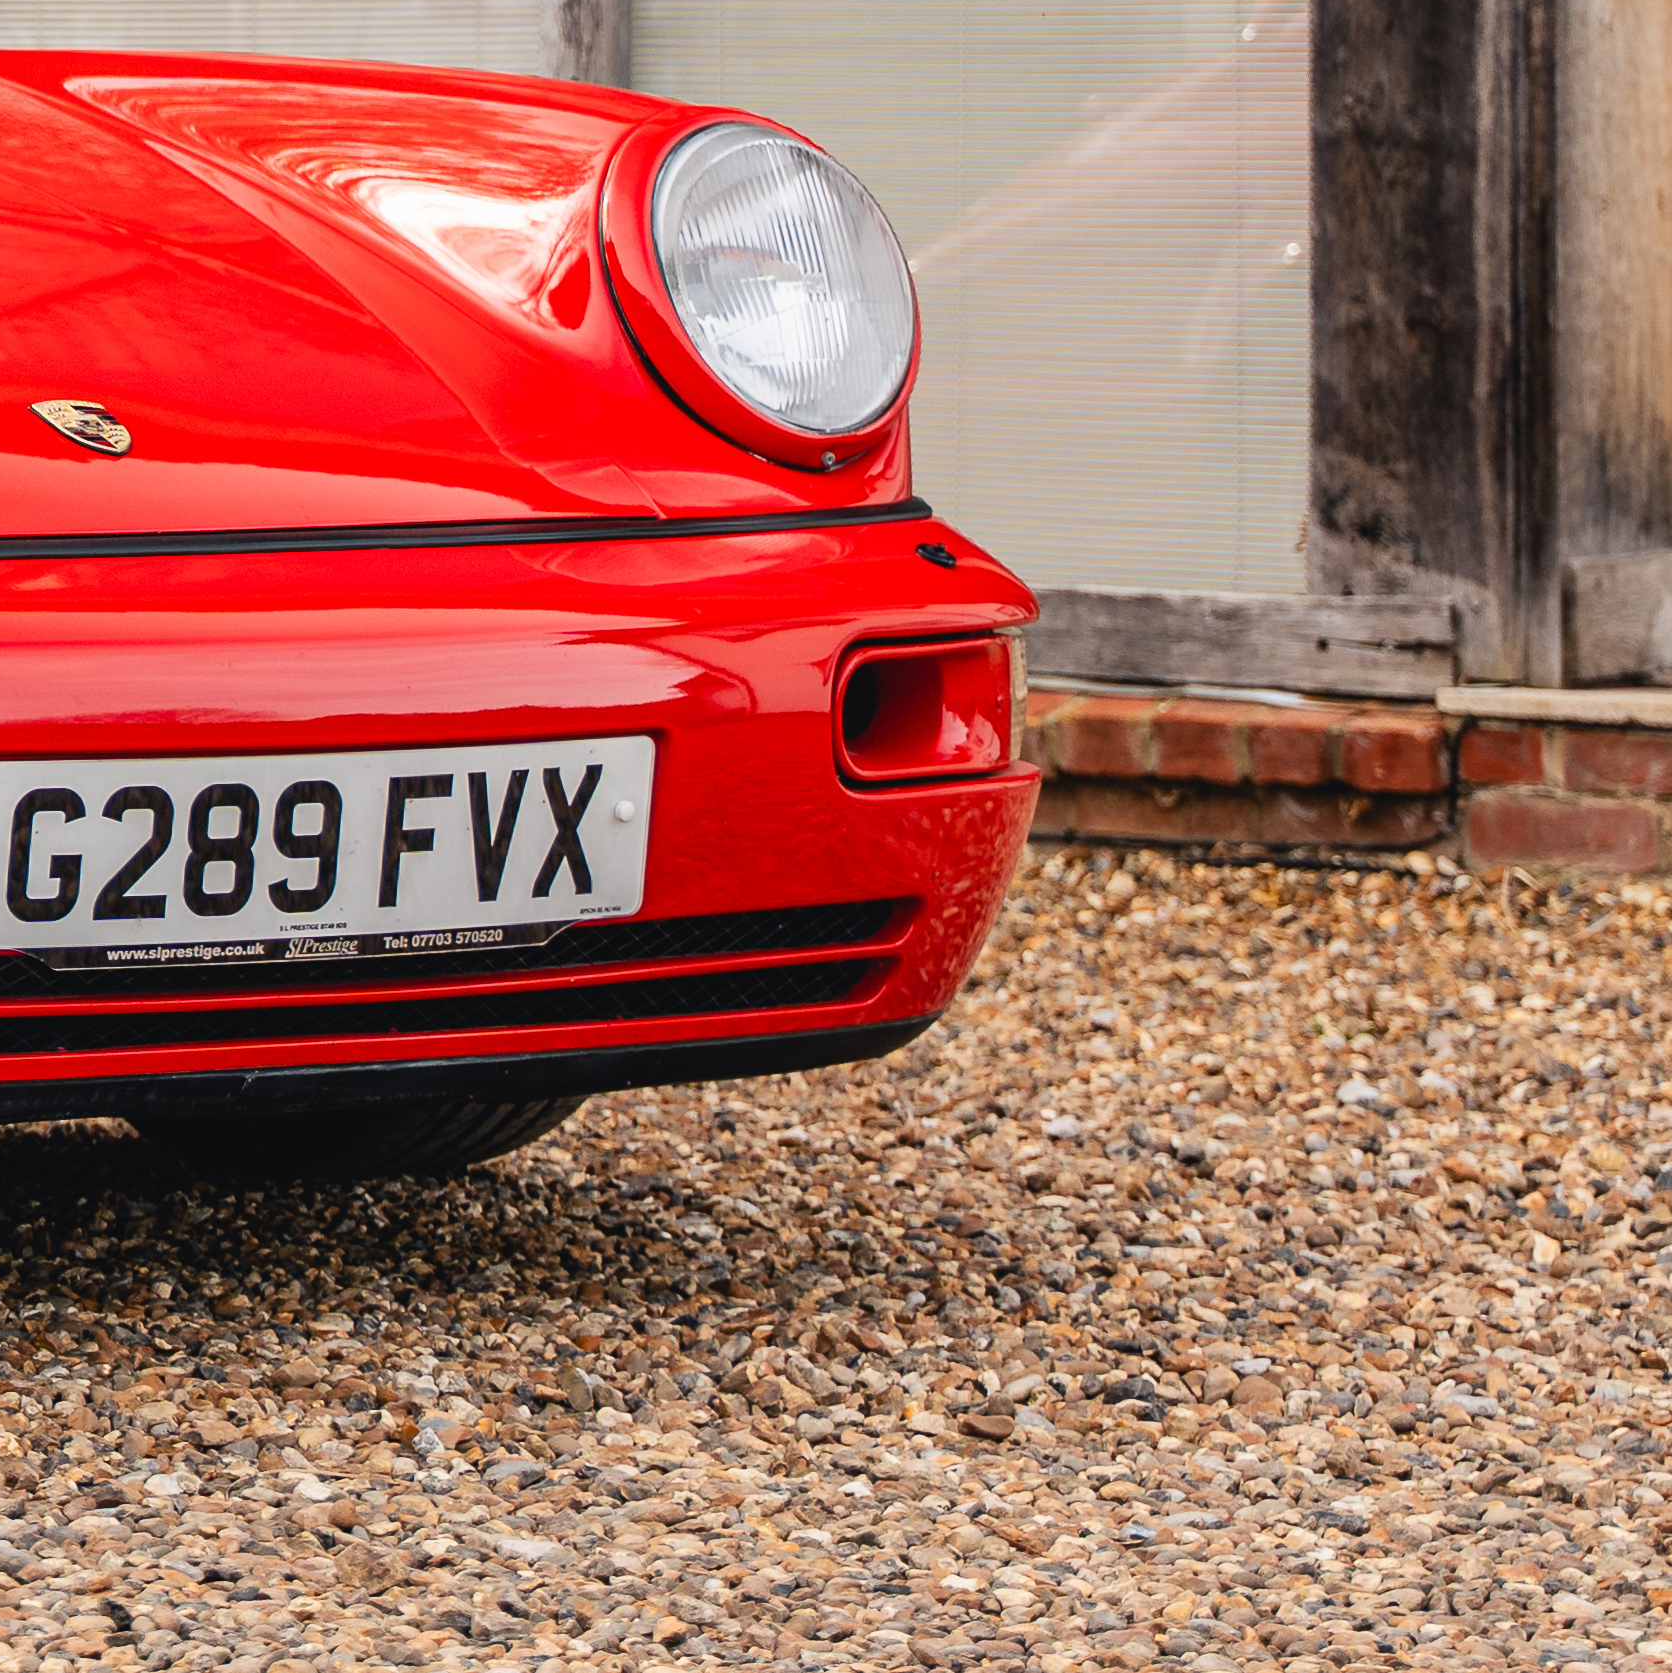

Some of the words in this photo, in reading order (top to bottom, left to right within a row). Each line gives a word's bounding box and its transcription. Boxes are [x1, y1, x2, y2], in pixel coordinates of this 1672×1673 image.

[5, 779, 343, 923] G289
[377, 763, 604, 909] FVX
[107, 942, 266, 962] www.slprestige.co.uk
[383, 936, 409, 950] Tel:
[411, 932, 452, 948] 07703
[455, 929, 504, 944] 570520
